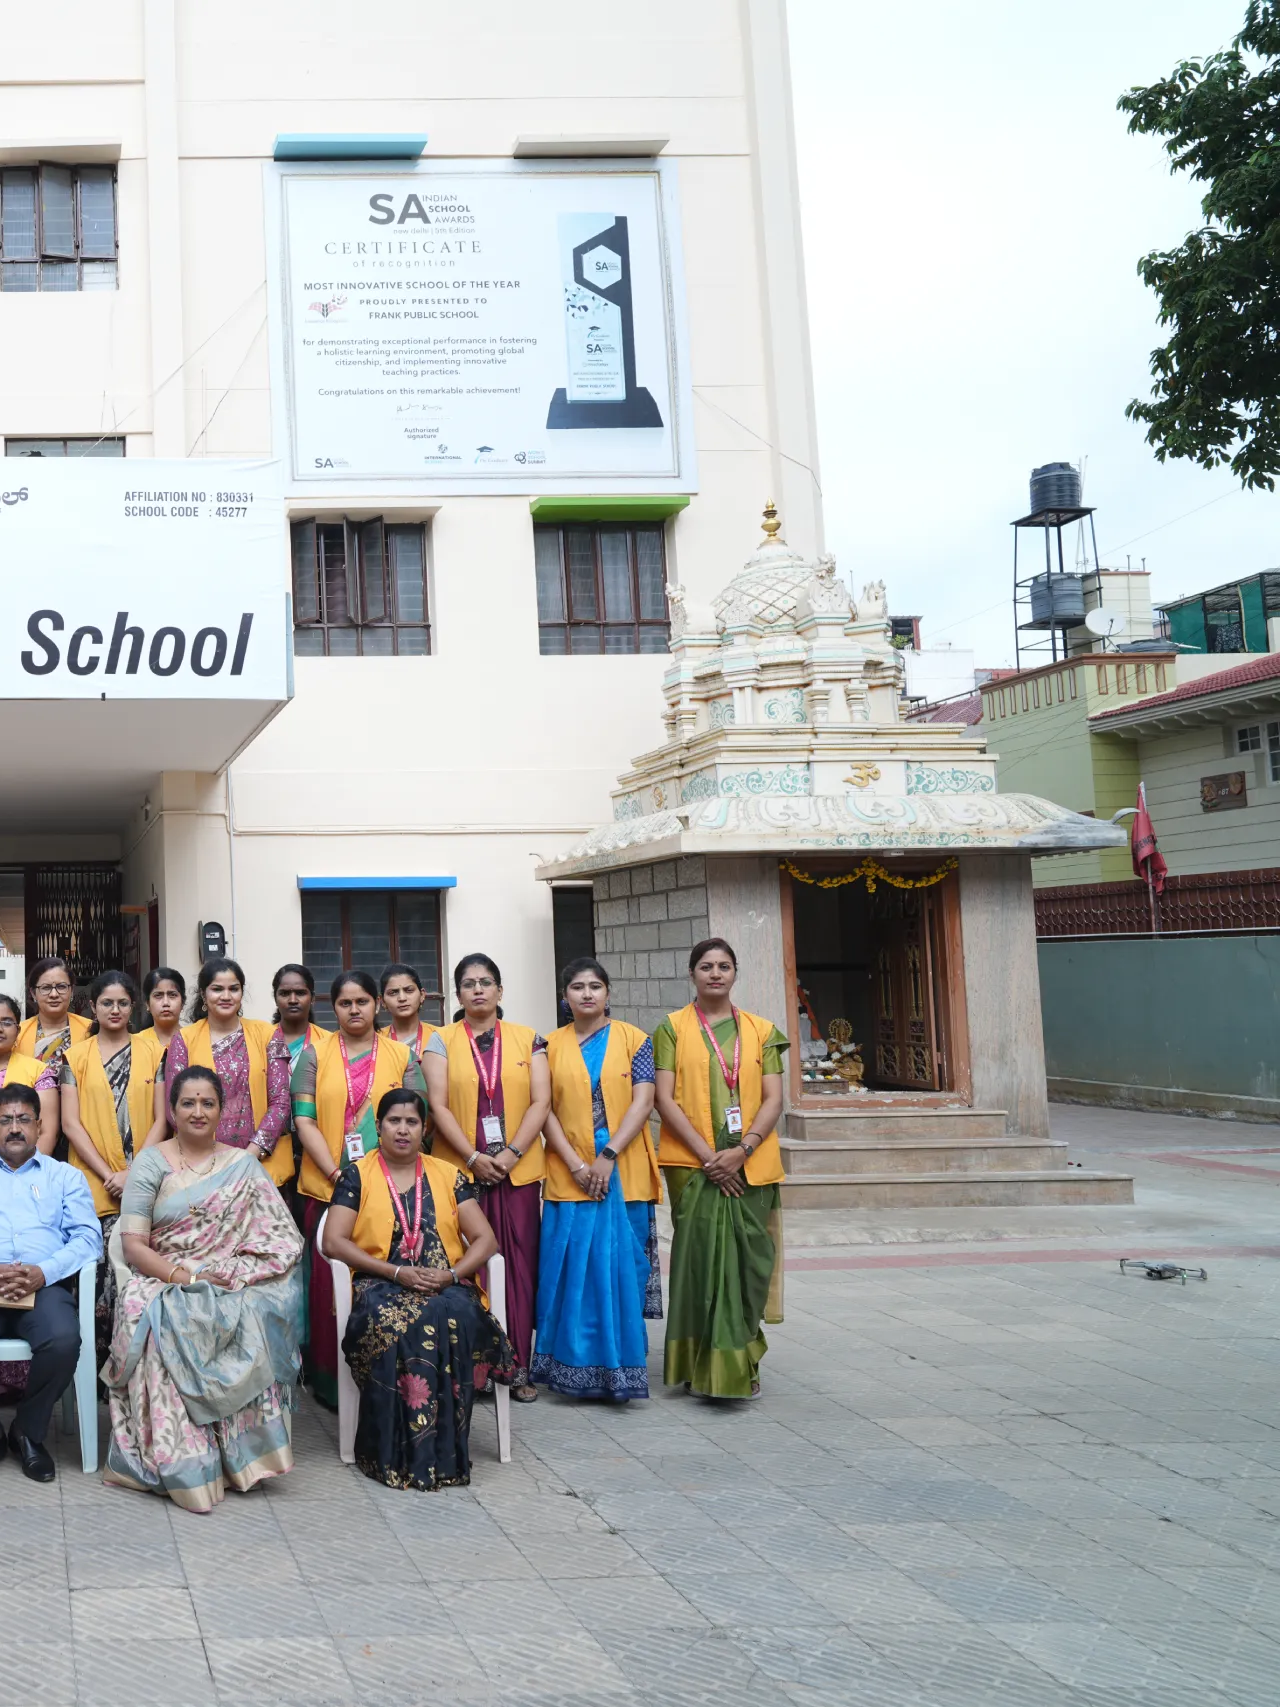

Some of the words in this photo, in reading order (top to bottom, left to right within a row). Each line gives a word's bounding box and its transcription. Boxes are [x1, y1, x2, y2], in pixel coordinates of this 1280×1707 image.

[324, 240, 482, 254] CERTIFICATE
[372, 259, 455, 268] recognition
[317, 338, 379, 347] demonstrating
[382, 337, 430, 346] exceptional
[433, 337, 486, 346] performance
[500, 336, 537, 345] fostering
[356, 348, 390, 356] learning
[393, 348, 448, 356] environment,
[452, 347, 496, 356] promoting
[498, 346, 524, 355] global
[335, 358, 382, 367] citizenship,
[403, 357, 461, 366] implementing
[382, 368, 418, 377] teaching
[421, 368, 460, 376] practices.
[318, 388, 384, 397] Congratulations
[124, 492, 187, 502] AFFILIATION
[192, 492, 206, 502] NO
[216, 492, 254, 503] 830331
[124, 506, 167, 517] SCHOOL
[171, 506, 199, 517] CODE
[216, 507, 248, 517] 45277
[21, 610, 253, 676] School
